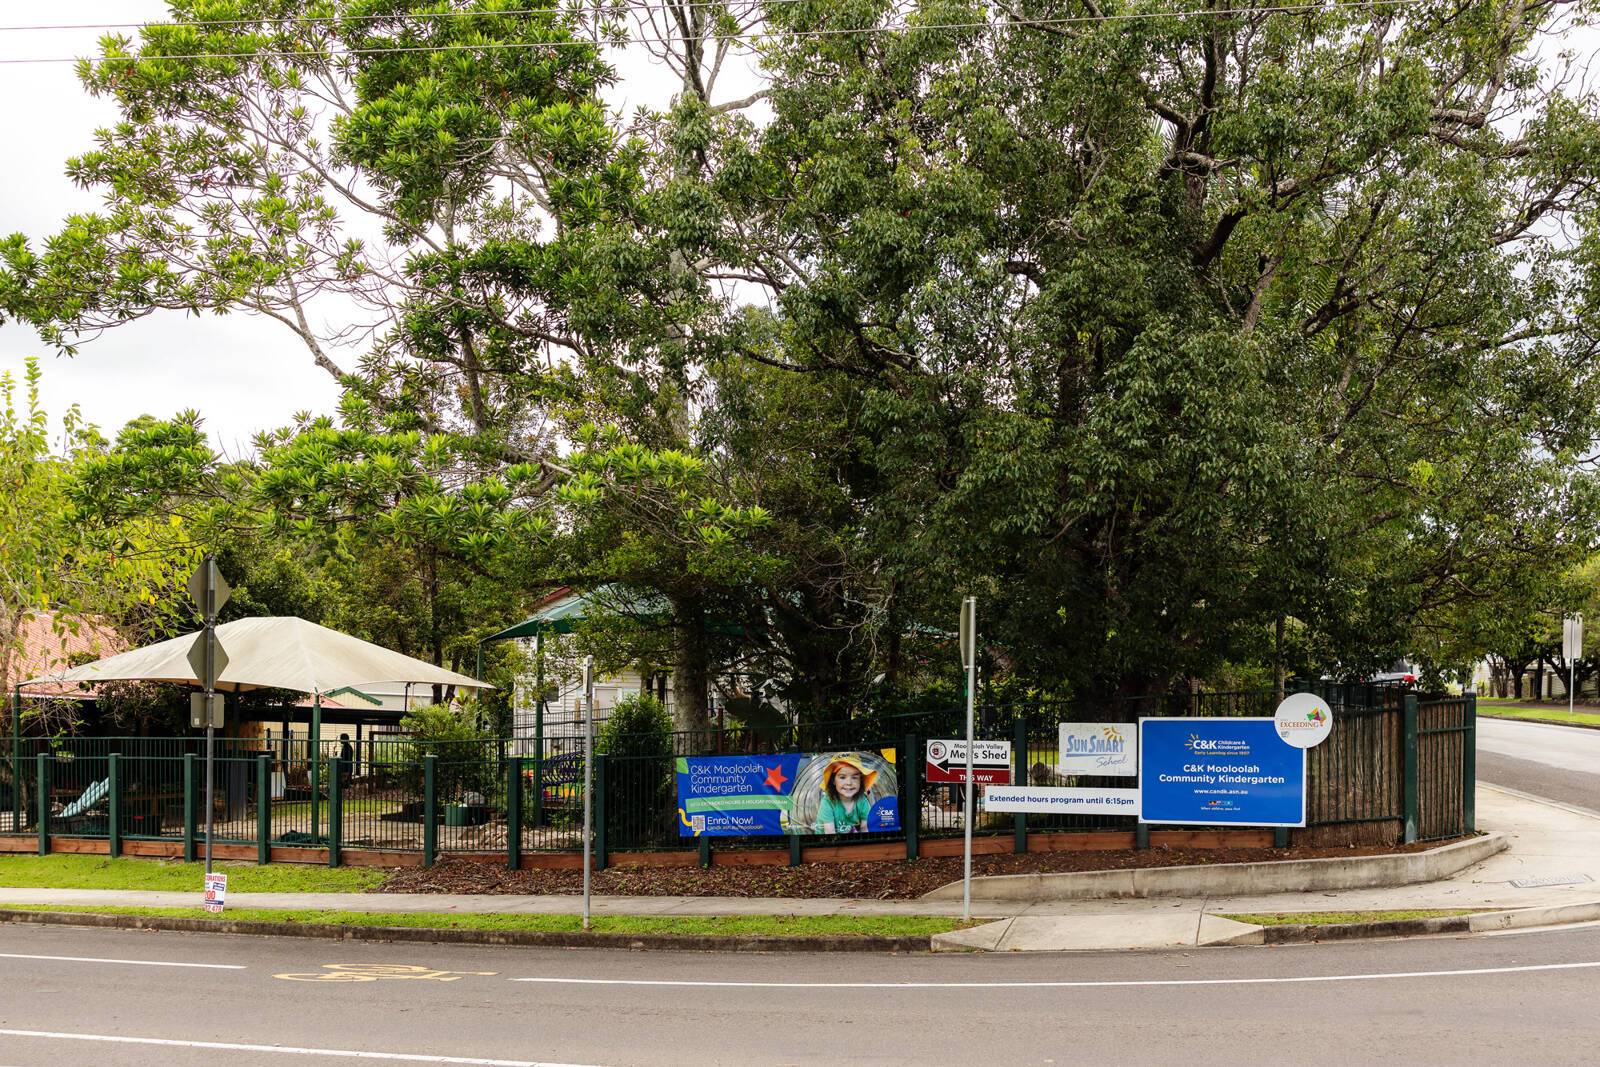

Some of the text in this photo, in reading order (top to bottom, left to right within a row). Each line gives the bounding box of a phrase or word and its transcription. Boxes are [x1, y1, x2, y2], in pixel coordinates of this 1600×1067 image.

[1193, 740, 1217, 749] C&K
[982, 750, 1007, 759] Shed
[1096, 754, 1128, 768] School
[691, 764, 764, 774] C&K Mooloolah
[1183, 765, 1260, 773] C&K Mooloolah
[691, 774, 746, 784] Community
[1159, 774, 1285, 784] Community Kindergarten
[691, 784, 753, 794] Kindergarten
[1027, 795, 1048, 803] hours
[1051, 797, 1084, 806] program
[707, 816, 754, 825] Enrol Now!
